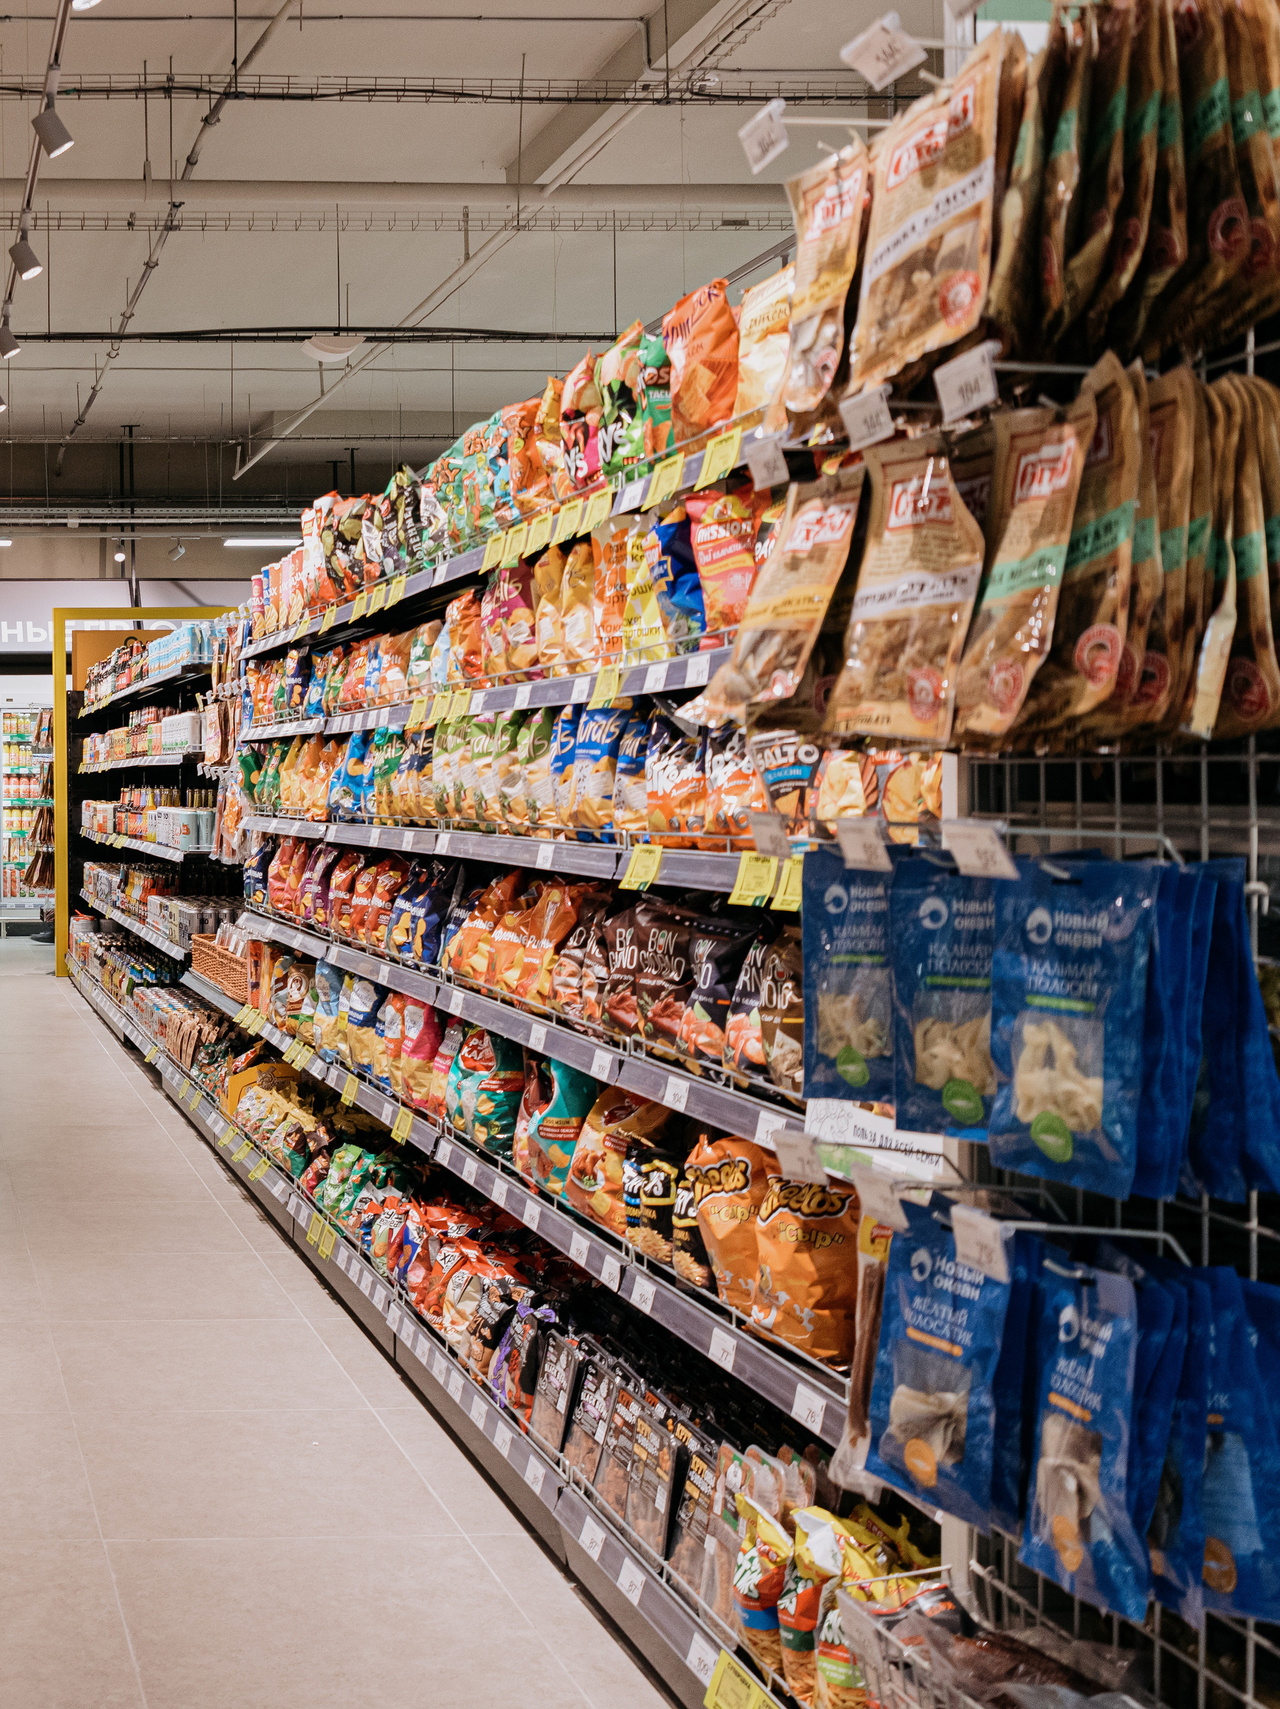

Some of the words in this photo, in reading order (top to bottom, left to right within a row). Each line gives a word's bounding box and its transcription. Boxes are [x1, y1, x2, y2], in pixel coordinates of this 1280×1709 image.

[756, 744, 820, 773] SALTO
[648, 928, 678, 956] BON
[853, 1125, 877, 1147] ПОЛЬЗА
